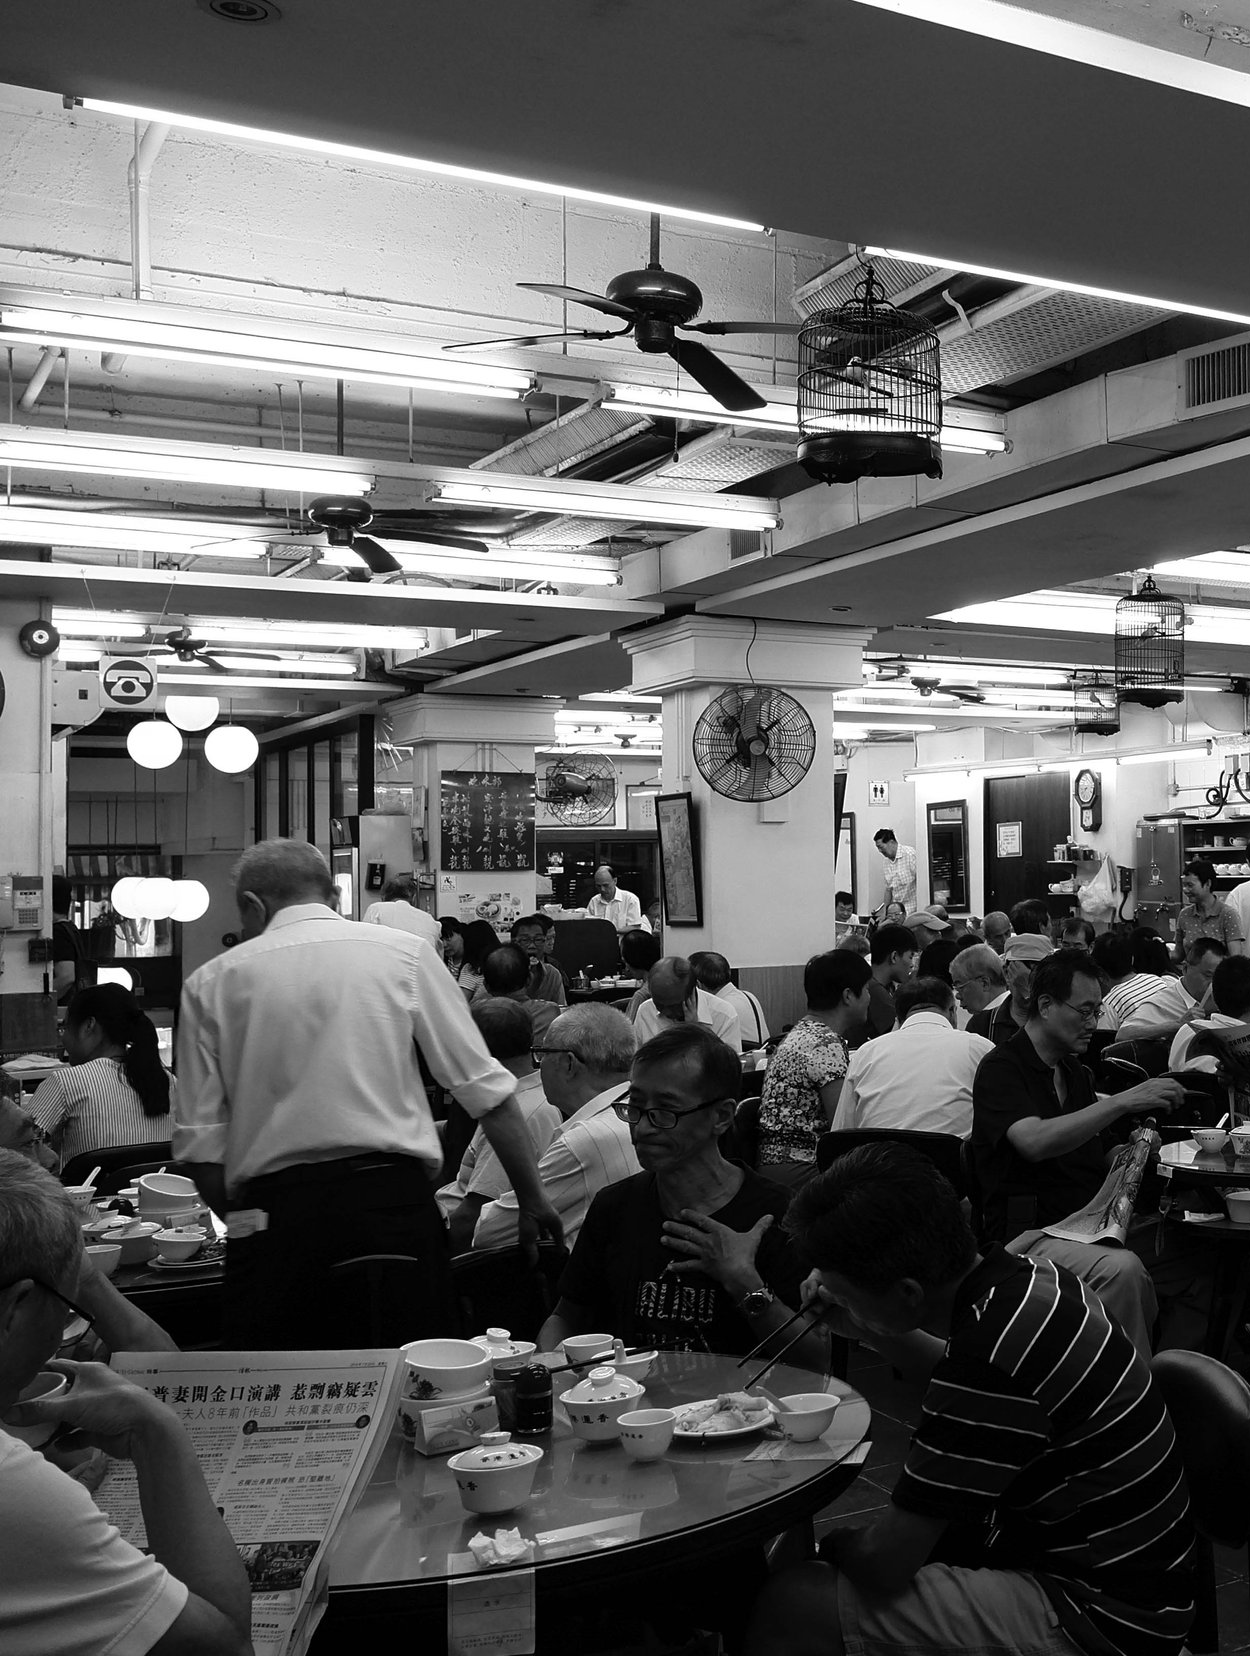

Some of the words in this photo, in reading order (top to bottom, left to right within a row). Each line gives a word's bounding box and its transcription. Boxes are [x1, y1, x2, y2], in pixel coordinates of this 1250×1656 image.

[146, 1383, 282, 1404] 普妻開金口演講
[290, 1380, 379, 1401] 惹剽竊疑雲
[284, 1401, 370, 1418] 共和黨裂痕仍深
